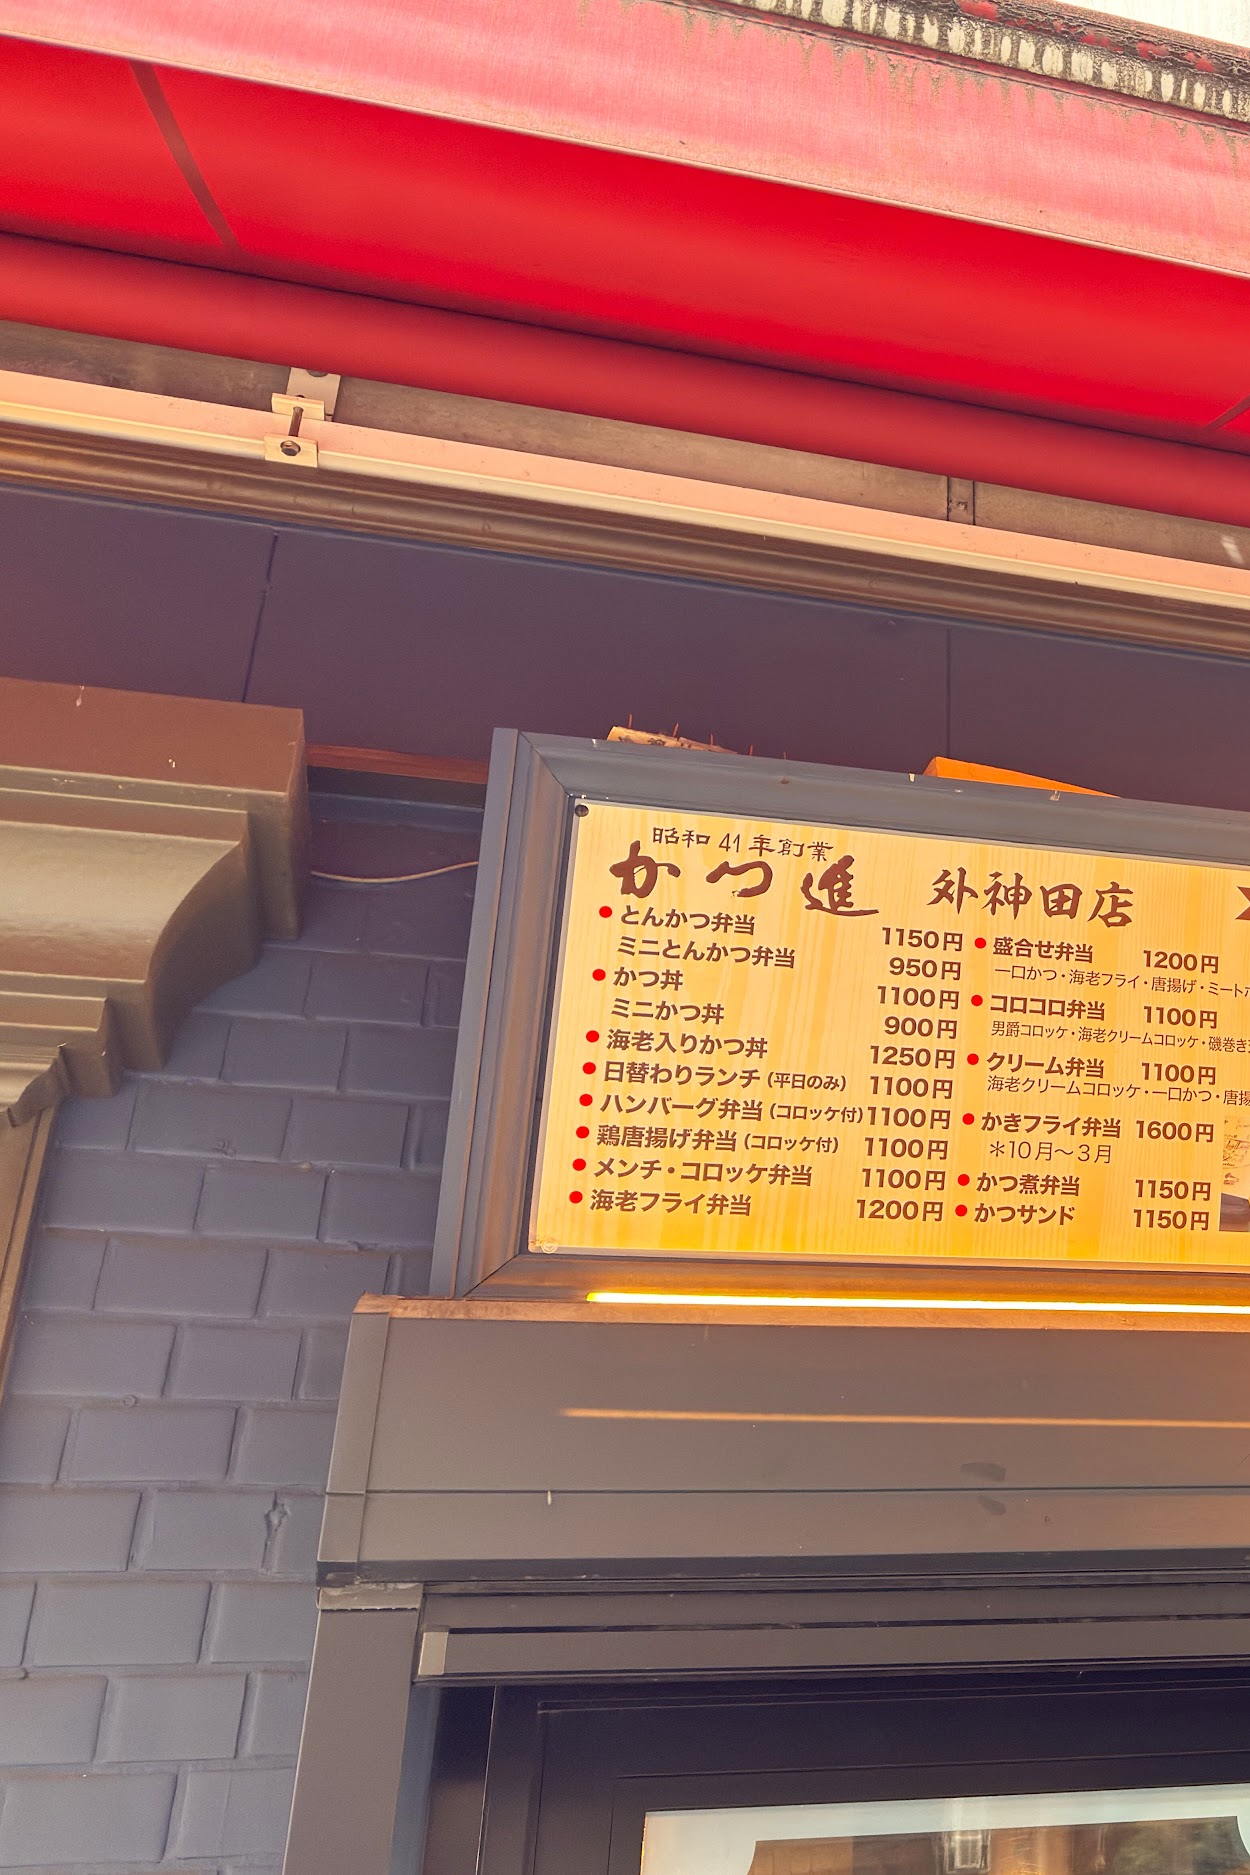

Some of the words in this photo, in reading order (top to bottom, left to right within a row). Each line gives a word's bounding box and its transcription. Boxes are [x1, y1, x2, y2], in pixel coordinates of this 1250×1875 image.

[653, 827, 834, 861] 昭和41年創業
[609, 839, 880, 917] かつ進
[926, 866, 1134, 928] 外神田店
[620, 904, 756, 935] とんかつ弁当
[880, 926, 963, 952] 1150円
[617, 935, 796, 969] ミニとんかつ弁当
[889, 956, 961, 981] 950円
[993, 936, 1093, 964] 盛合せ弁当
[1142, 949, 1219, 974] 1200円
[614, 966, 683, 991] かつ丼
[877, 985, 960, 1010] 1100円
[610, 997, 725, 1025] ミニかつ丼
[884, 1015, 958, 1040] 900円
[990, 994, 1105, 1021] コロコロ弁当
[1143, 1005, 1218, 1029] 1100円
[606, 1028, 768, 1059] 海老入りかつ丼
[869, 1044, 956, 1070] 1250円
[603, 1060, 760, 1089] 日替わりランチ
[868, 1075, 954, 1100] 1100円
[986, 1052, 1104, 1079] クリーム弁当
[1141, 1062, 1216, 1085] 1100円
[600, 1093, 763, 1121] ハンバーグ弁当
[866, 1105, 951, 1130] 1100円
[981, 1111, 1121, 1139] かきフライ弁当
[1135, 1120, 1214, 1143] 1600円
[596, 1124, 737, 1152] 鶏唐揚げ弁当
[864, 1136, 949, 1160] 1100円
[593, 1157, 812, 1187] メンチ・コロッケ弁当
[861, 1167, 946, 1191] 1100円
[976, 1173, 1080, 1196] かつ煮弁当
[1135, 1179, 1211, 1201] 1150円
[590, 1188, 751, 1217] 海老フライ弁当
[856, 1198, 943, 1222] 1200円
[974, 1202, 1075, 1226] かつサンド
[1133, 1208, 1209, 1231] 1150円
